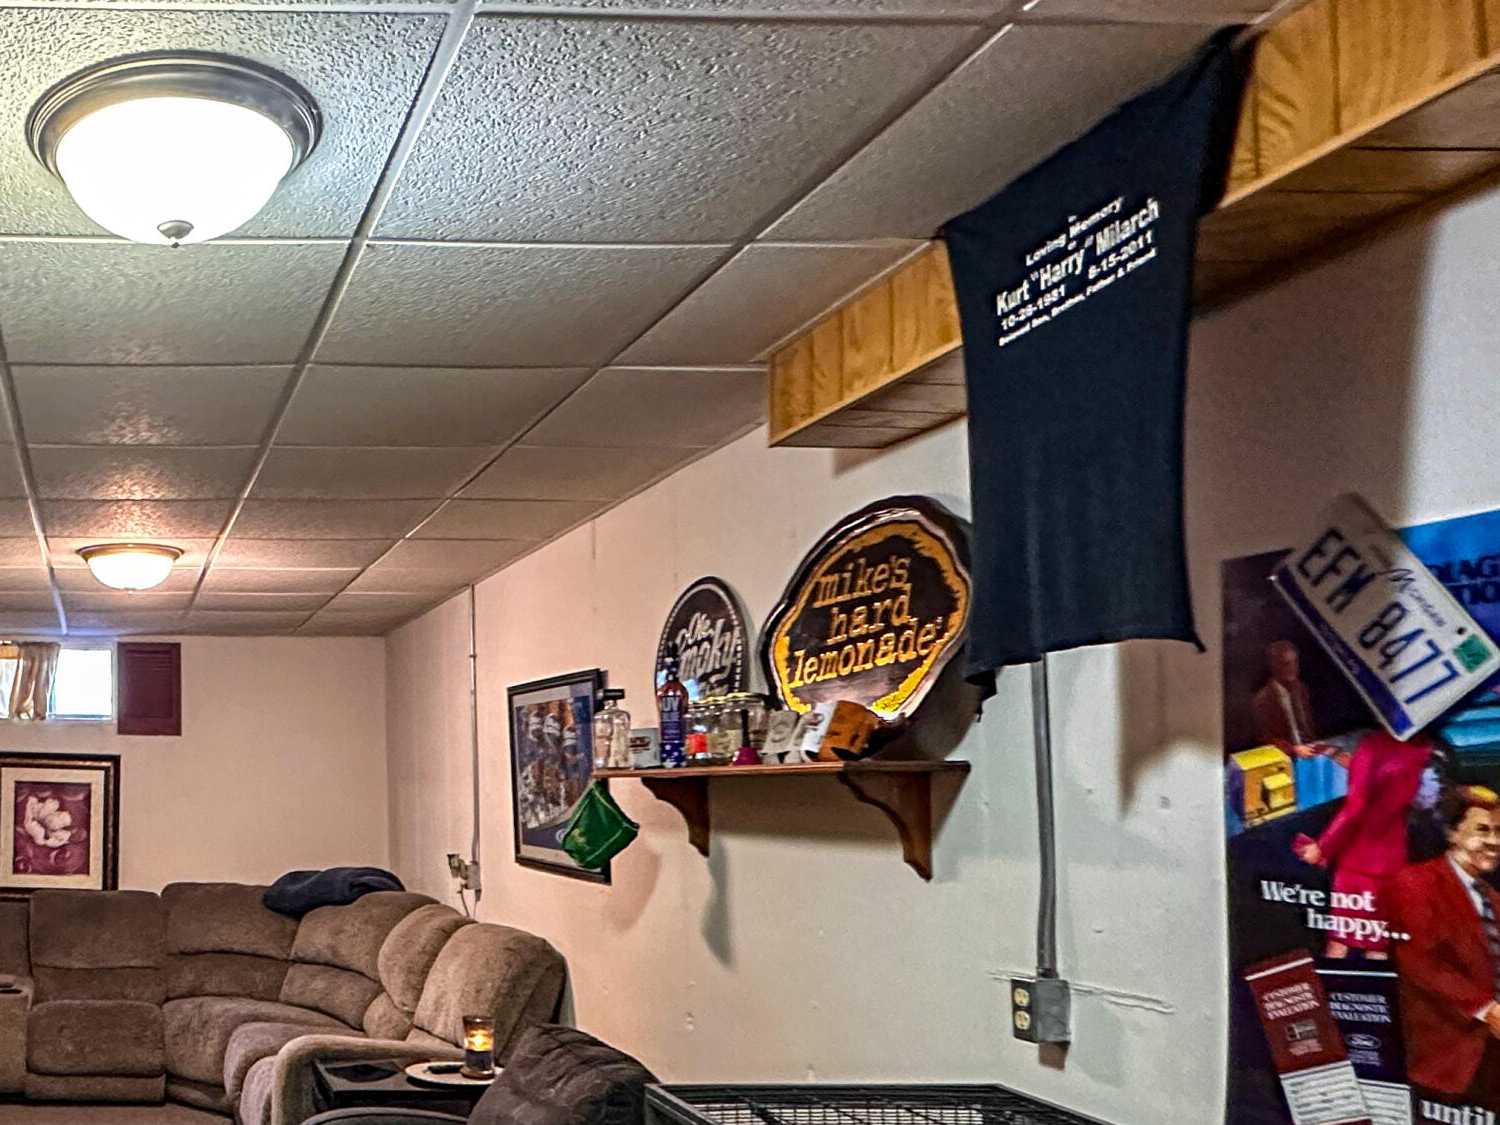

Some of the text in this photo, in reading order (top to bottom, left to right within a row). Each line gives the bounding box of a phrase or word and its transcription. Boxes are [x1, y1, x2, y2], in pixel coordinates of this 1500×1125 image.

[1025, 196, 1125, 266] Loving Memory
[996, 279, 1030, 316] Kurt
[813, 555, 912, 608] mike's
[826, 583, 912, 644] hard
[1358, 601, 1460, 704] 8477
[662, 697, 680, 712] UV
[1260, 880, 1376, 912] We're not
[1306, 907, 1411, 942] happy...
